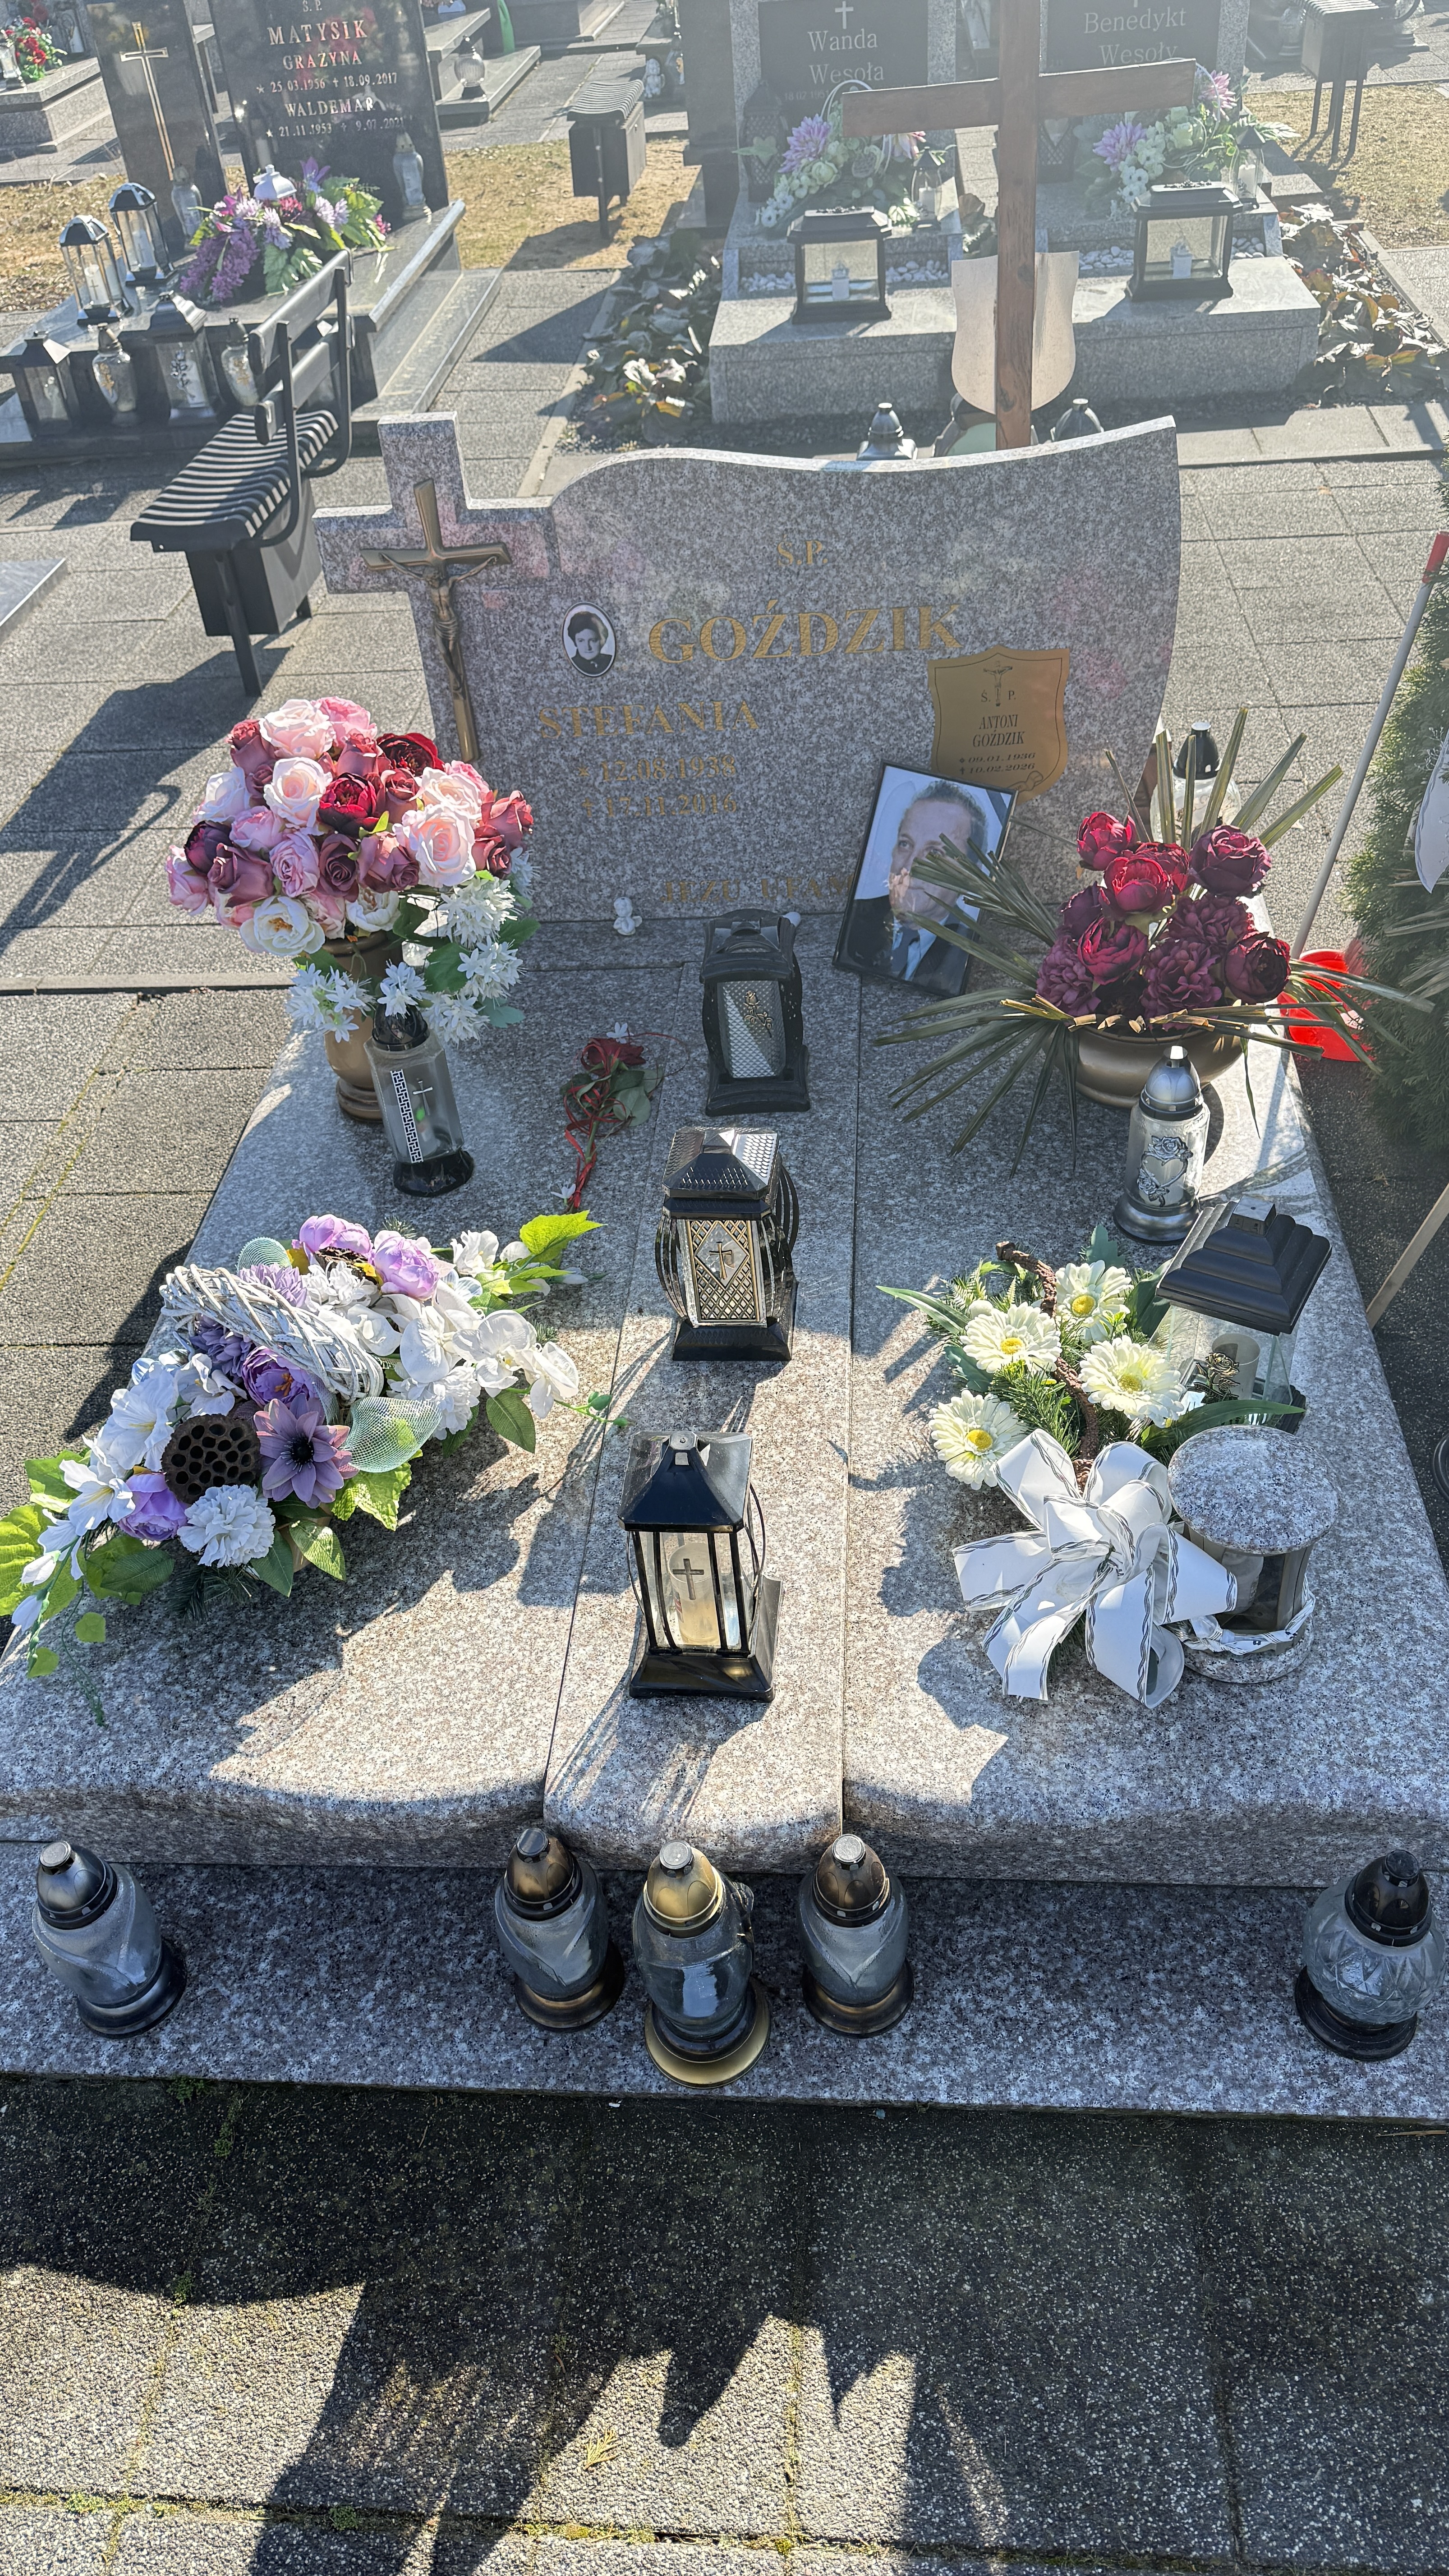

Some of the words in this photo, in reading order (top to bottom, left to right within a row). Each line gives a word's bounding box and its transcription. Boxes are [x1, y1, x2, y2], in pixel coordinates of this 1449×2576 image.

[315, 0, 322, 10] P.
[267, 20, 368, 45] MATYSIK
[1084, 7, 1186, 34] Benedykt
[808, 28, 878, 52] Wanda
[283, 51, 362, 70] GRAŻYNA
[1100, 42, 1178, 66] Wesoły
[271, 78, 325, 92] 2503.1956
[344, 72, 397, 87] 18.09.2017
[809, 62, 884, 85] Wesoła
[284, 97, 376, 117] WALDEMAR
[648, 599, 963, 663] GOŹDZIK
[980, 690, 991, 702] Ś.
[1008, 690, 1016, 700] P.
[539, 699, 760, 739] STEFANIA
[979, 714, 1018, 729] ANTONI
[973, 729, 1025, 747] GOŹDZIK
[600, 754, 736, 782] 12.08.1938
[606, 792, 737, 818] 17.11.2016
[660, 879, 740, 902] JEZU
[760, 874, 854, 899] UFAM
